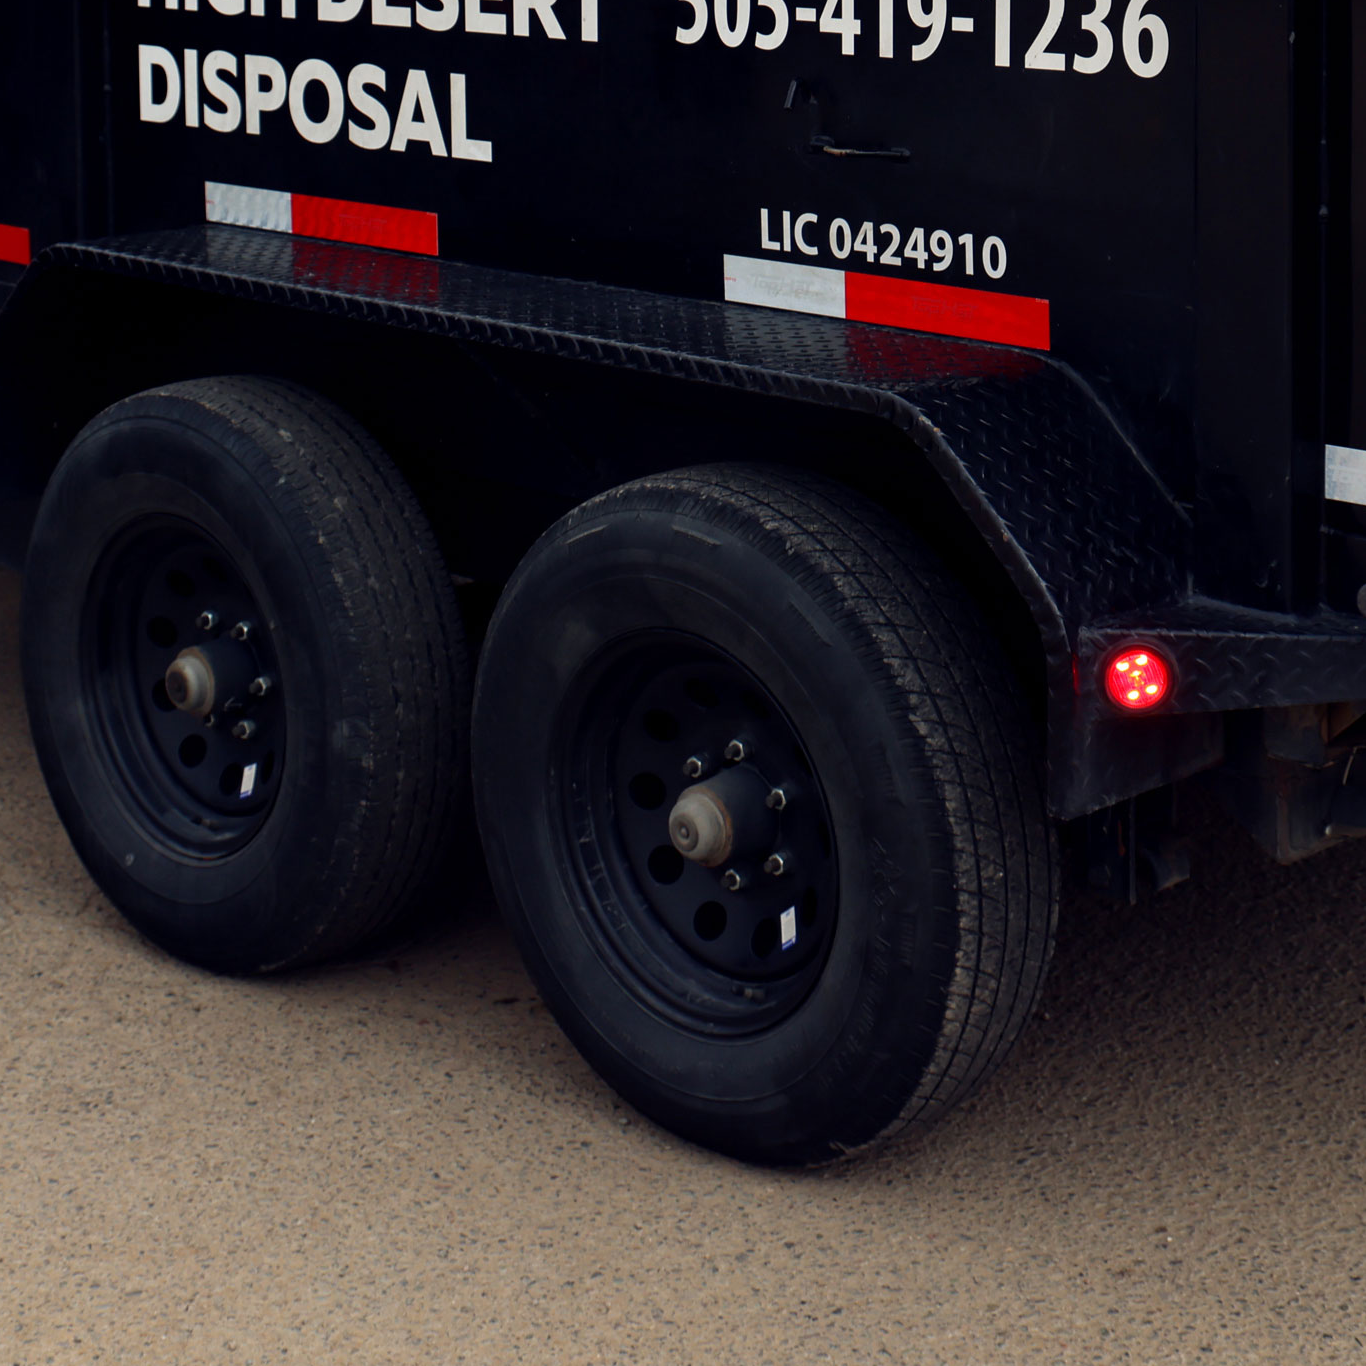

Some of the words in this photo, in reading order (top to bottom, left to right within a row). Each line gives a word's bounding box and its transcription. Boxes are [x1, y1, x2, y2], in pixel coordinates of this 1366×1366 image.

[139, 45, 492, 162] DISPOSAL
[761, 208, 818, 255] LIC
[829, 218, 1007, 278] 0424910
